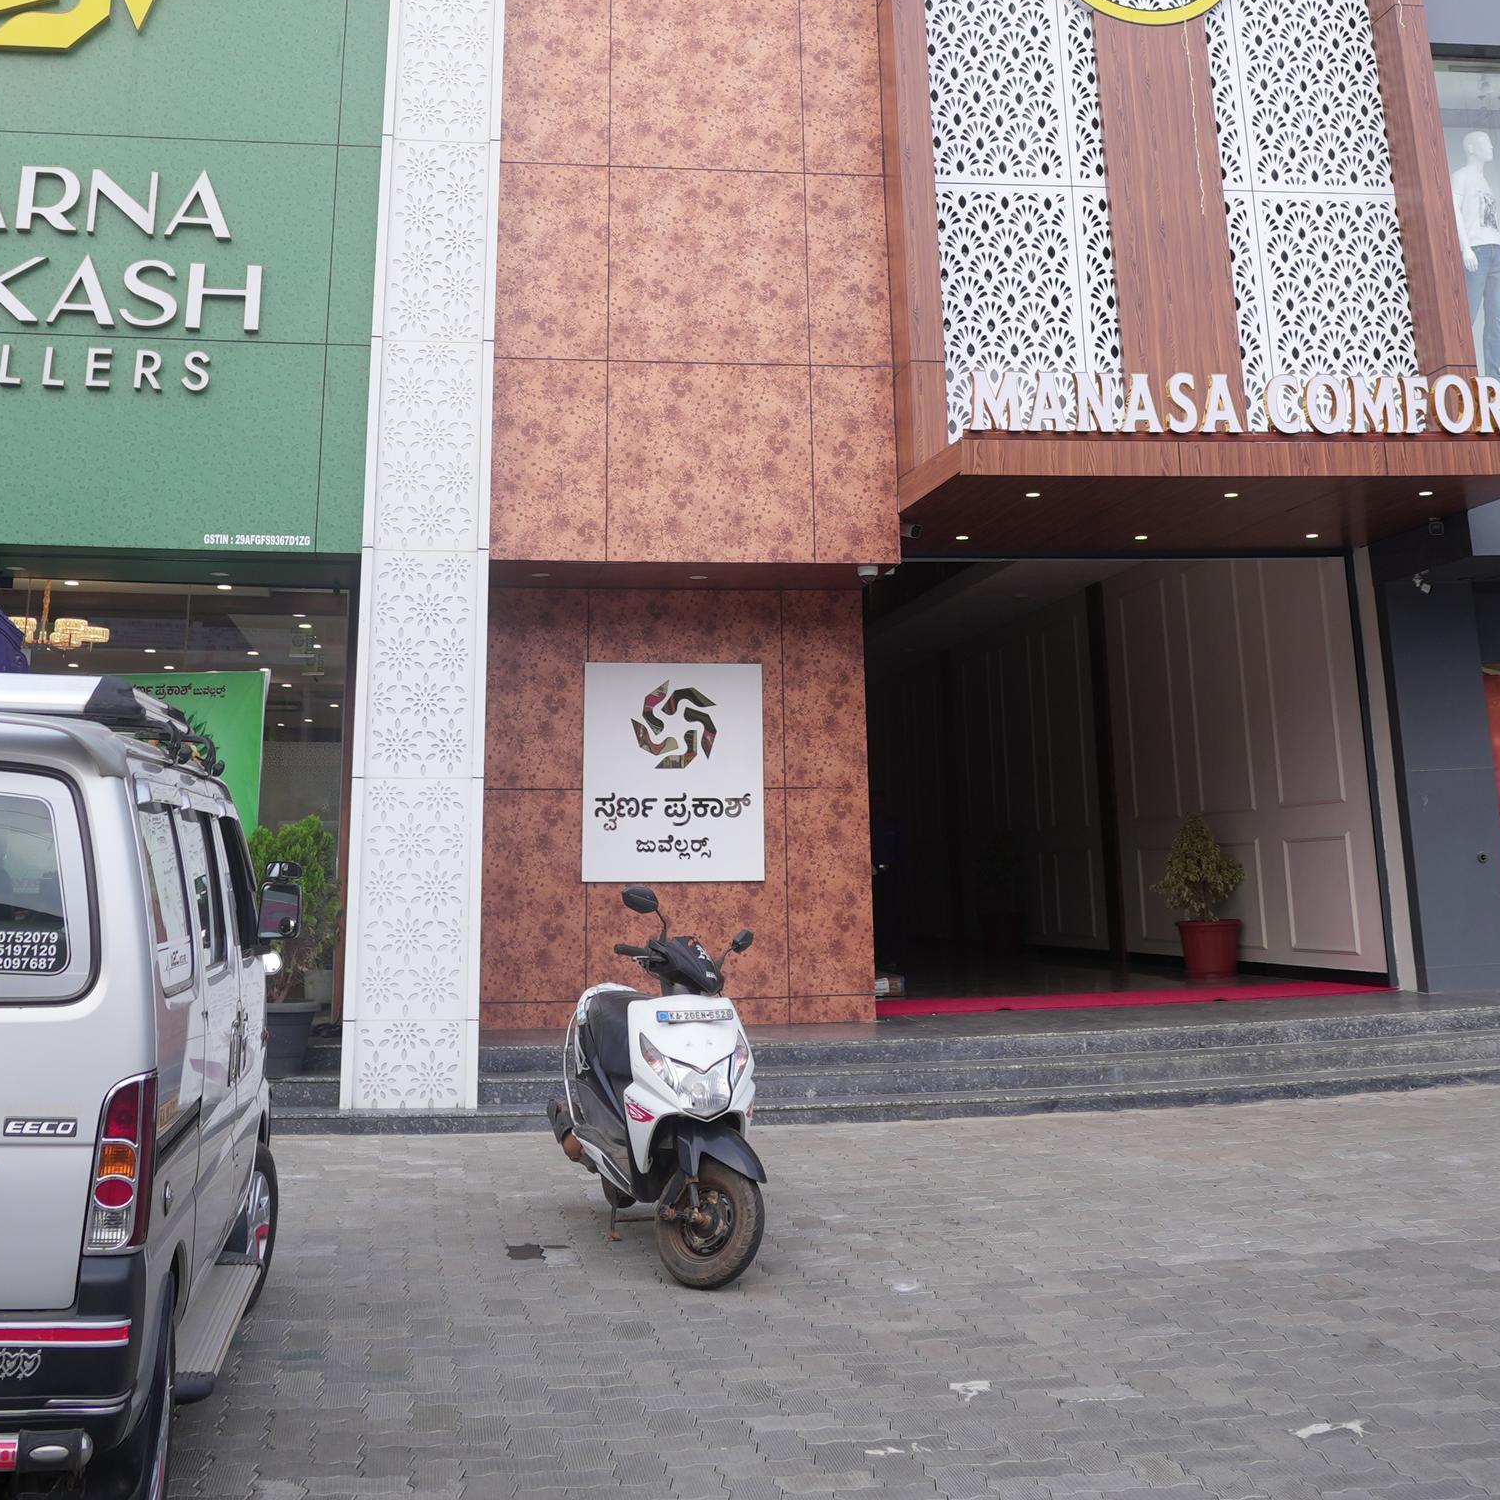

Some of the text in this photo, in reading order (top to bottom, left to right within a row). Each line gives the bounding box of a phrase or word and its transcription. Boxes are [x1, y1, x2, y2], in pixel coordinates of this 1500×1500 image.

[969, 370, 1243, 435] MANASA
[204, 533, 229, 545] GSTIN
[155, 683, 192, 700] ಪ್ರಕಾಶ್
[594, 792, 751, 831] ಸ್ವರ್ಣ ಪ್ರಕಾಶ್
[4, 1121, 76, 1134] EECO
